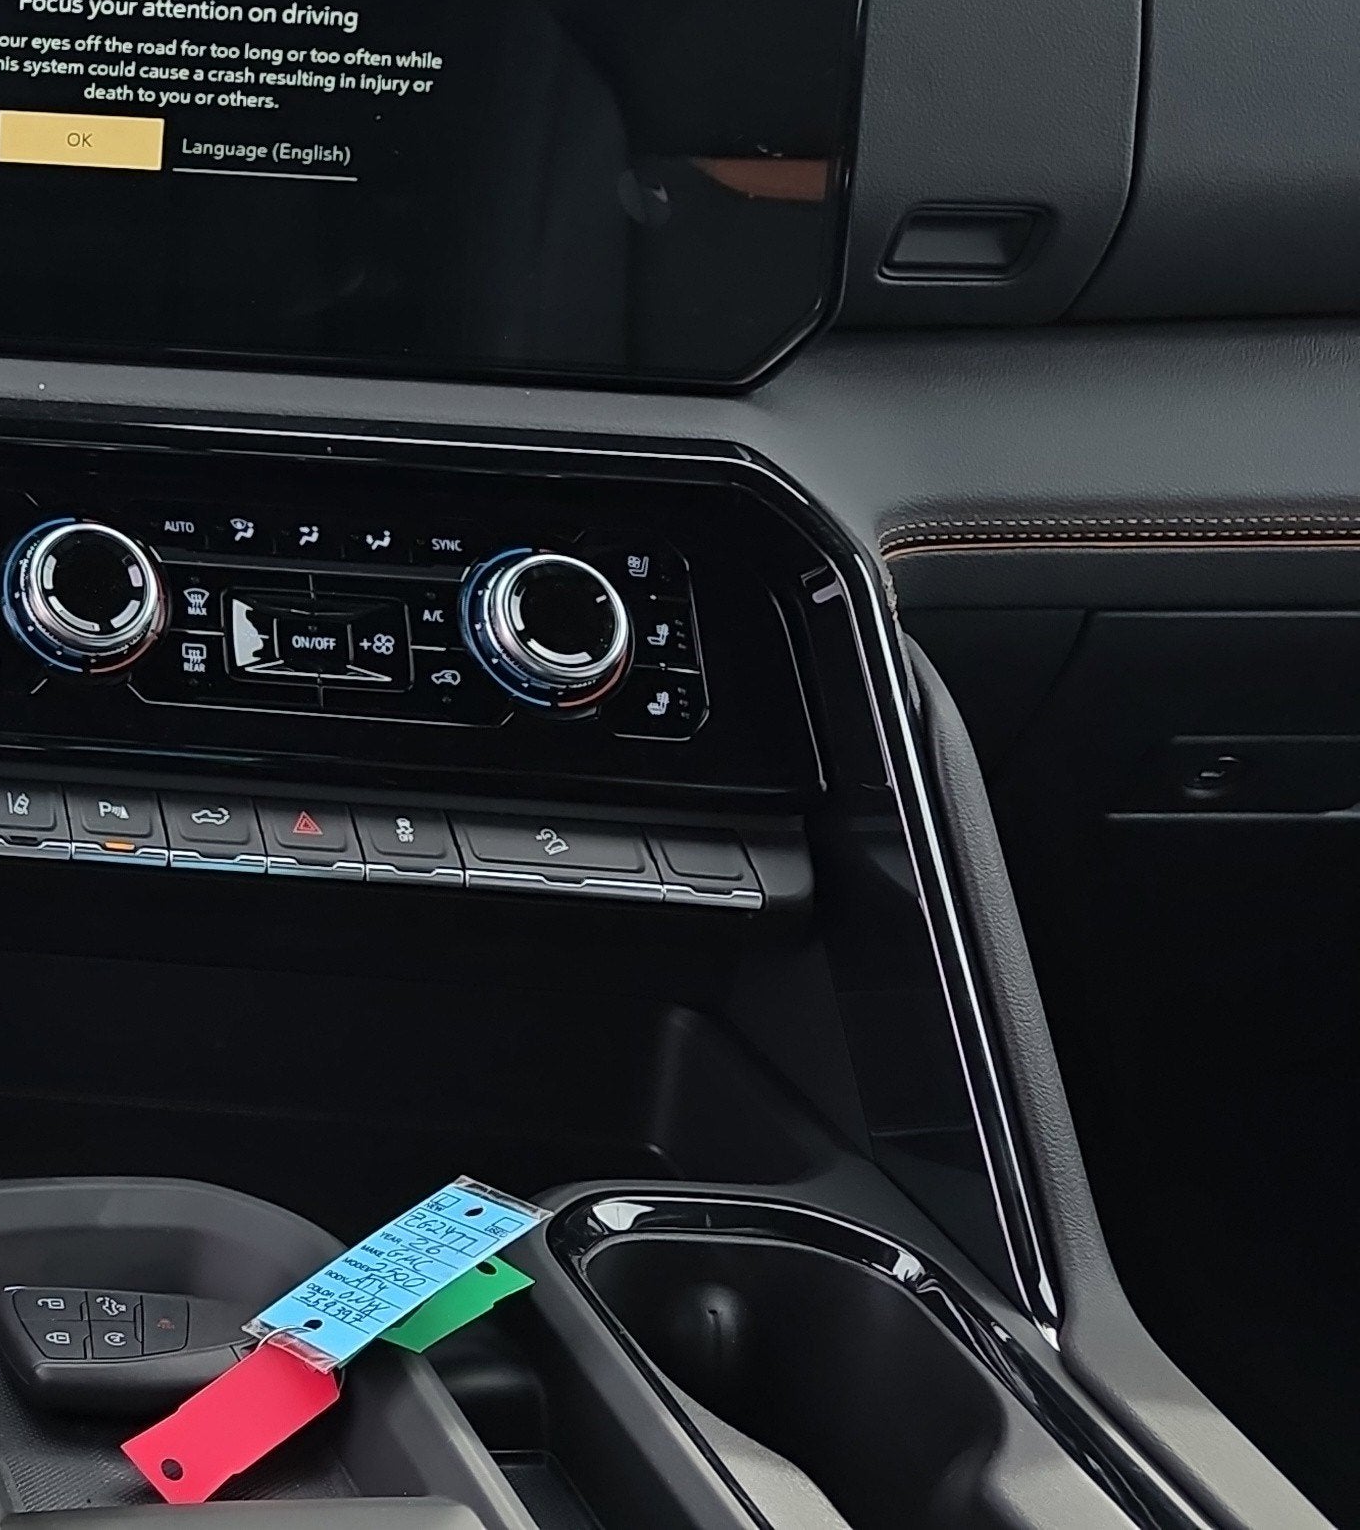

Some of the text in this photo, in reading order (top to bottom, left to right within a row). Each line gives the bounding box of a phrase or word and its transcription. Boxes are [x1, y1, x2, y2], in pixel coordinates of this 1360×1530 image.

[247, 6, 278, 24] on
[281, 2, 359, 33] driving
[31, 36, 72, 55] eyes
[74, 35, 103, 52] off
[104, 36, 133, 54] the
[136, 39, 178, 57] road
[180, 39, 207, 57] for
[209, 42, 241, 60] too
[243, 42, 284, 66] long
[286, 50, 307, 63] or
[310, 47, 341, 64] too
[343, 48, 392, 67] often
[395, 50, 443, 70] while
[22, 59, 85, 77] system
[87, 60, 136, 79] could
[138, 66, 190, 81] cause
[192, 69, 204, 82] a
[207, 66, 255, 84] crash
[258, 68, 336, 93] resulting
[339, 72, 356, 89] in
[359, 73, 410, 97] injury
[412, 79, 434, 94] or
[83, 82, 279, 109] death to you or others.
[66, 132, 93, 149] OK
[181, 138, 352, 167] Language (English)
[163, 519, 196, 534] AUTO
[431, 537, 464, 552] SYNC
[422, 608, 445, 624] A/C
[291, 635, 337, 652] ON/OFF
[380, 1231, 445, 1255] YEAR 26
[360, 1244, 434, 1271] MAKE GMC
[324, 1269, 349, 1284] BODY
[341, 1257, 427, 1288] MODEL 2500
[306, 1282, 335, 1298] COLOR
